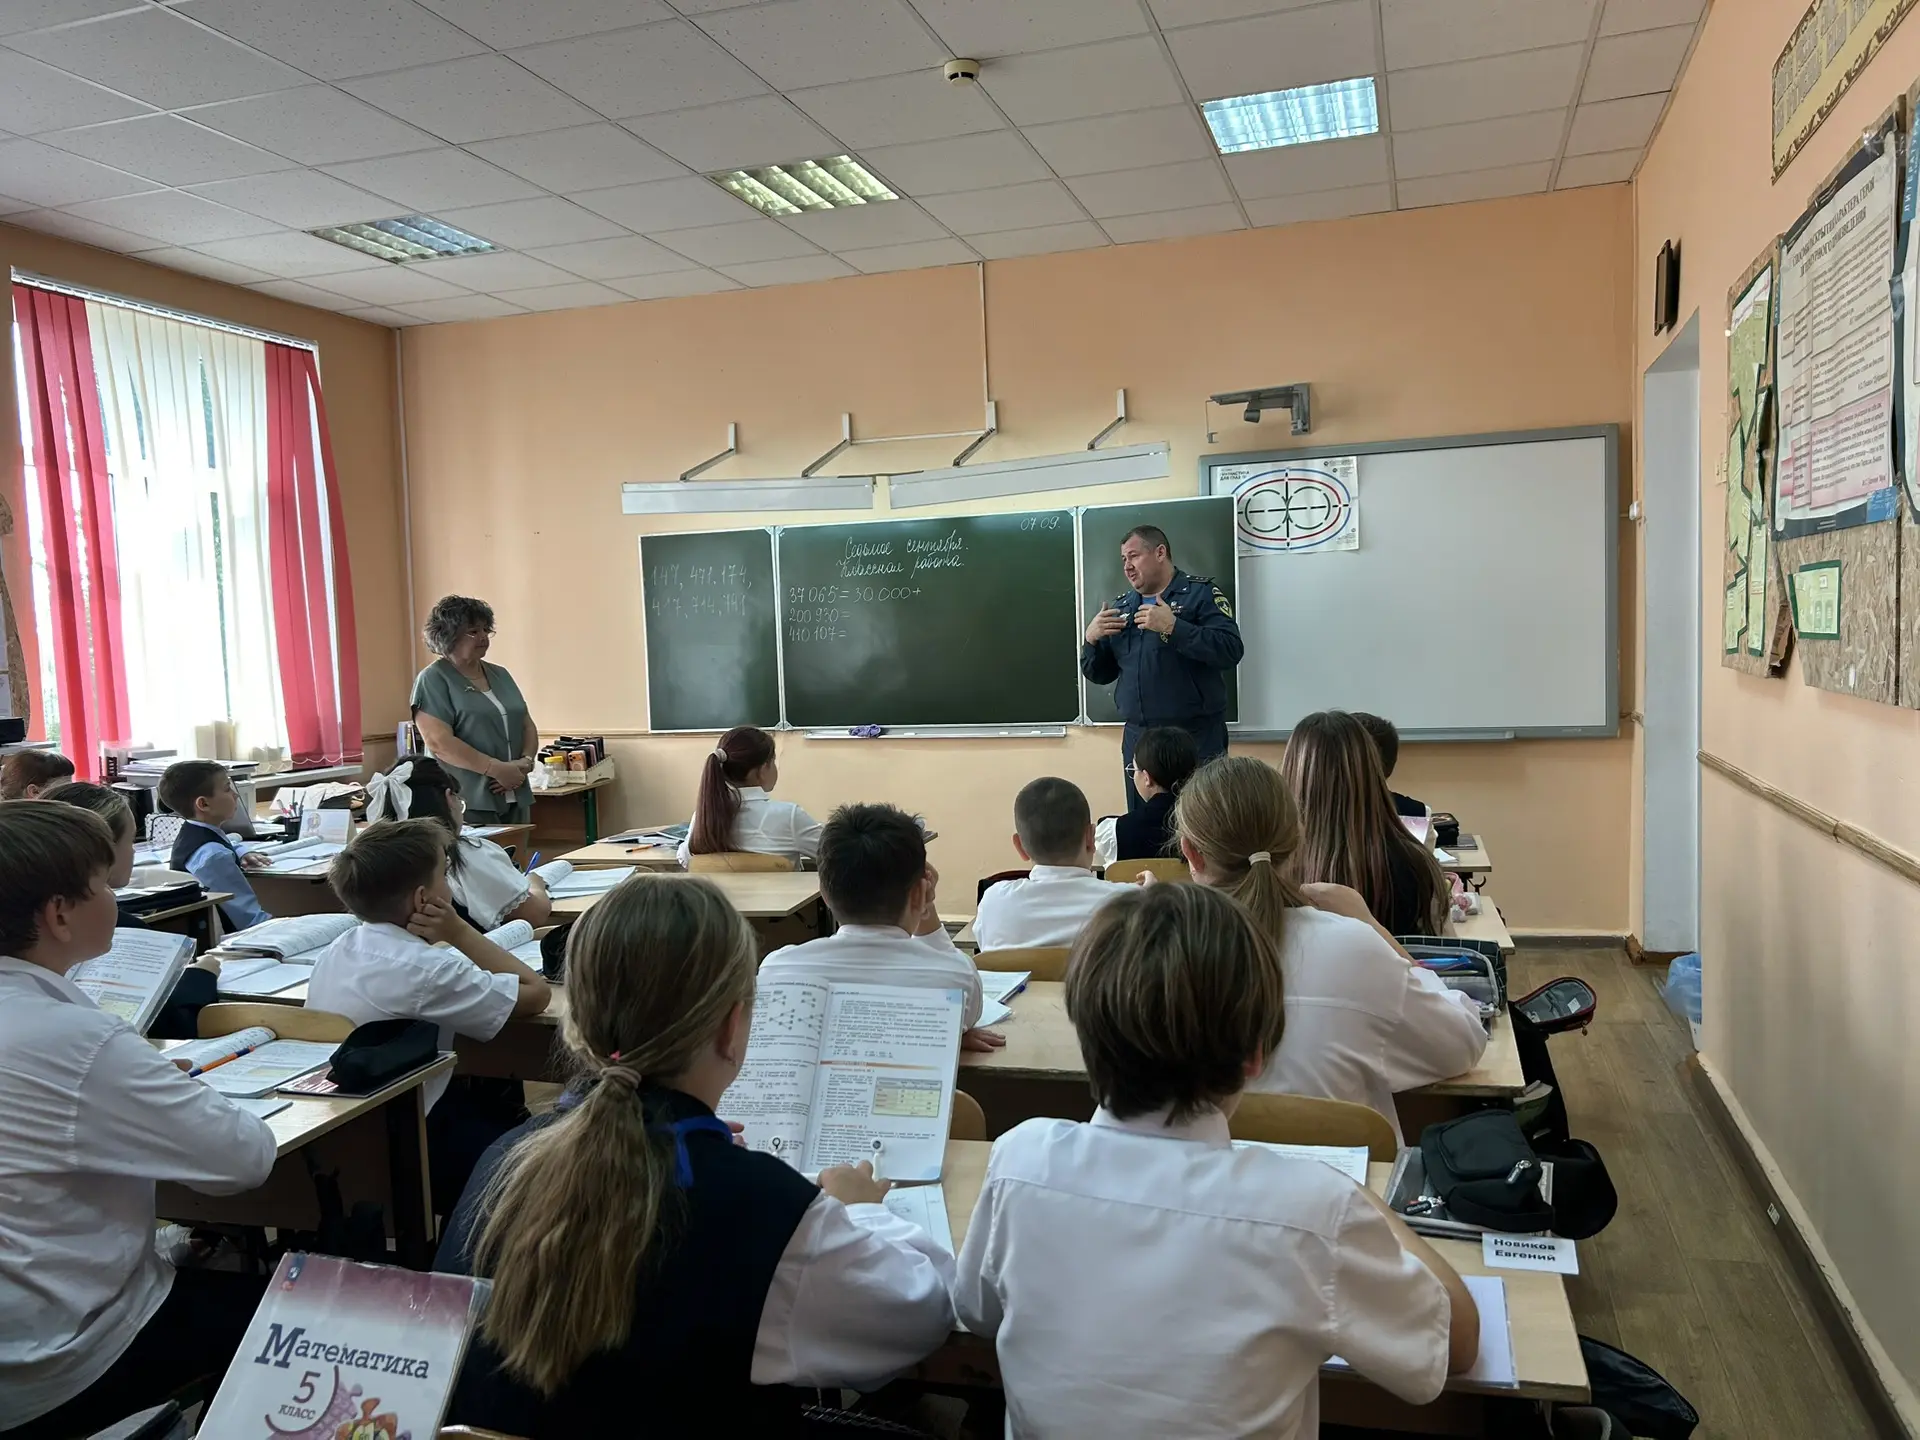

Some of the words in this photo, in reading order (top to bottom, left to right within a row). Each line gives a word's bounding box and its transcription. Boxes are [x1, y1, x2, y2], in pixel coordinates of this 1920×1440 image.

[845, 536, 894, 560] Седьмое
[836, 558, 904, 578] Классная
[1493, 1238, 1556, 1251] Новиков
[1494, 1249, 1556, 1262] Евгений
[254, 1323, 429, 1379] Математика
[292, 1370, 321, 1404] 5
